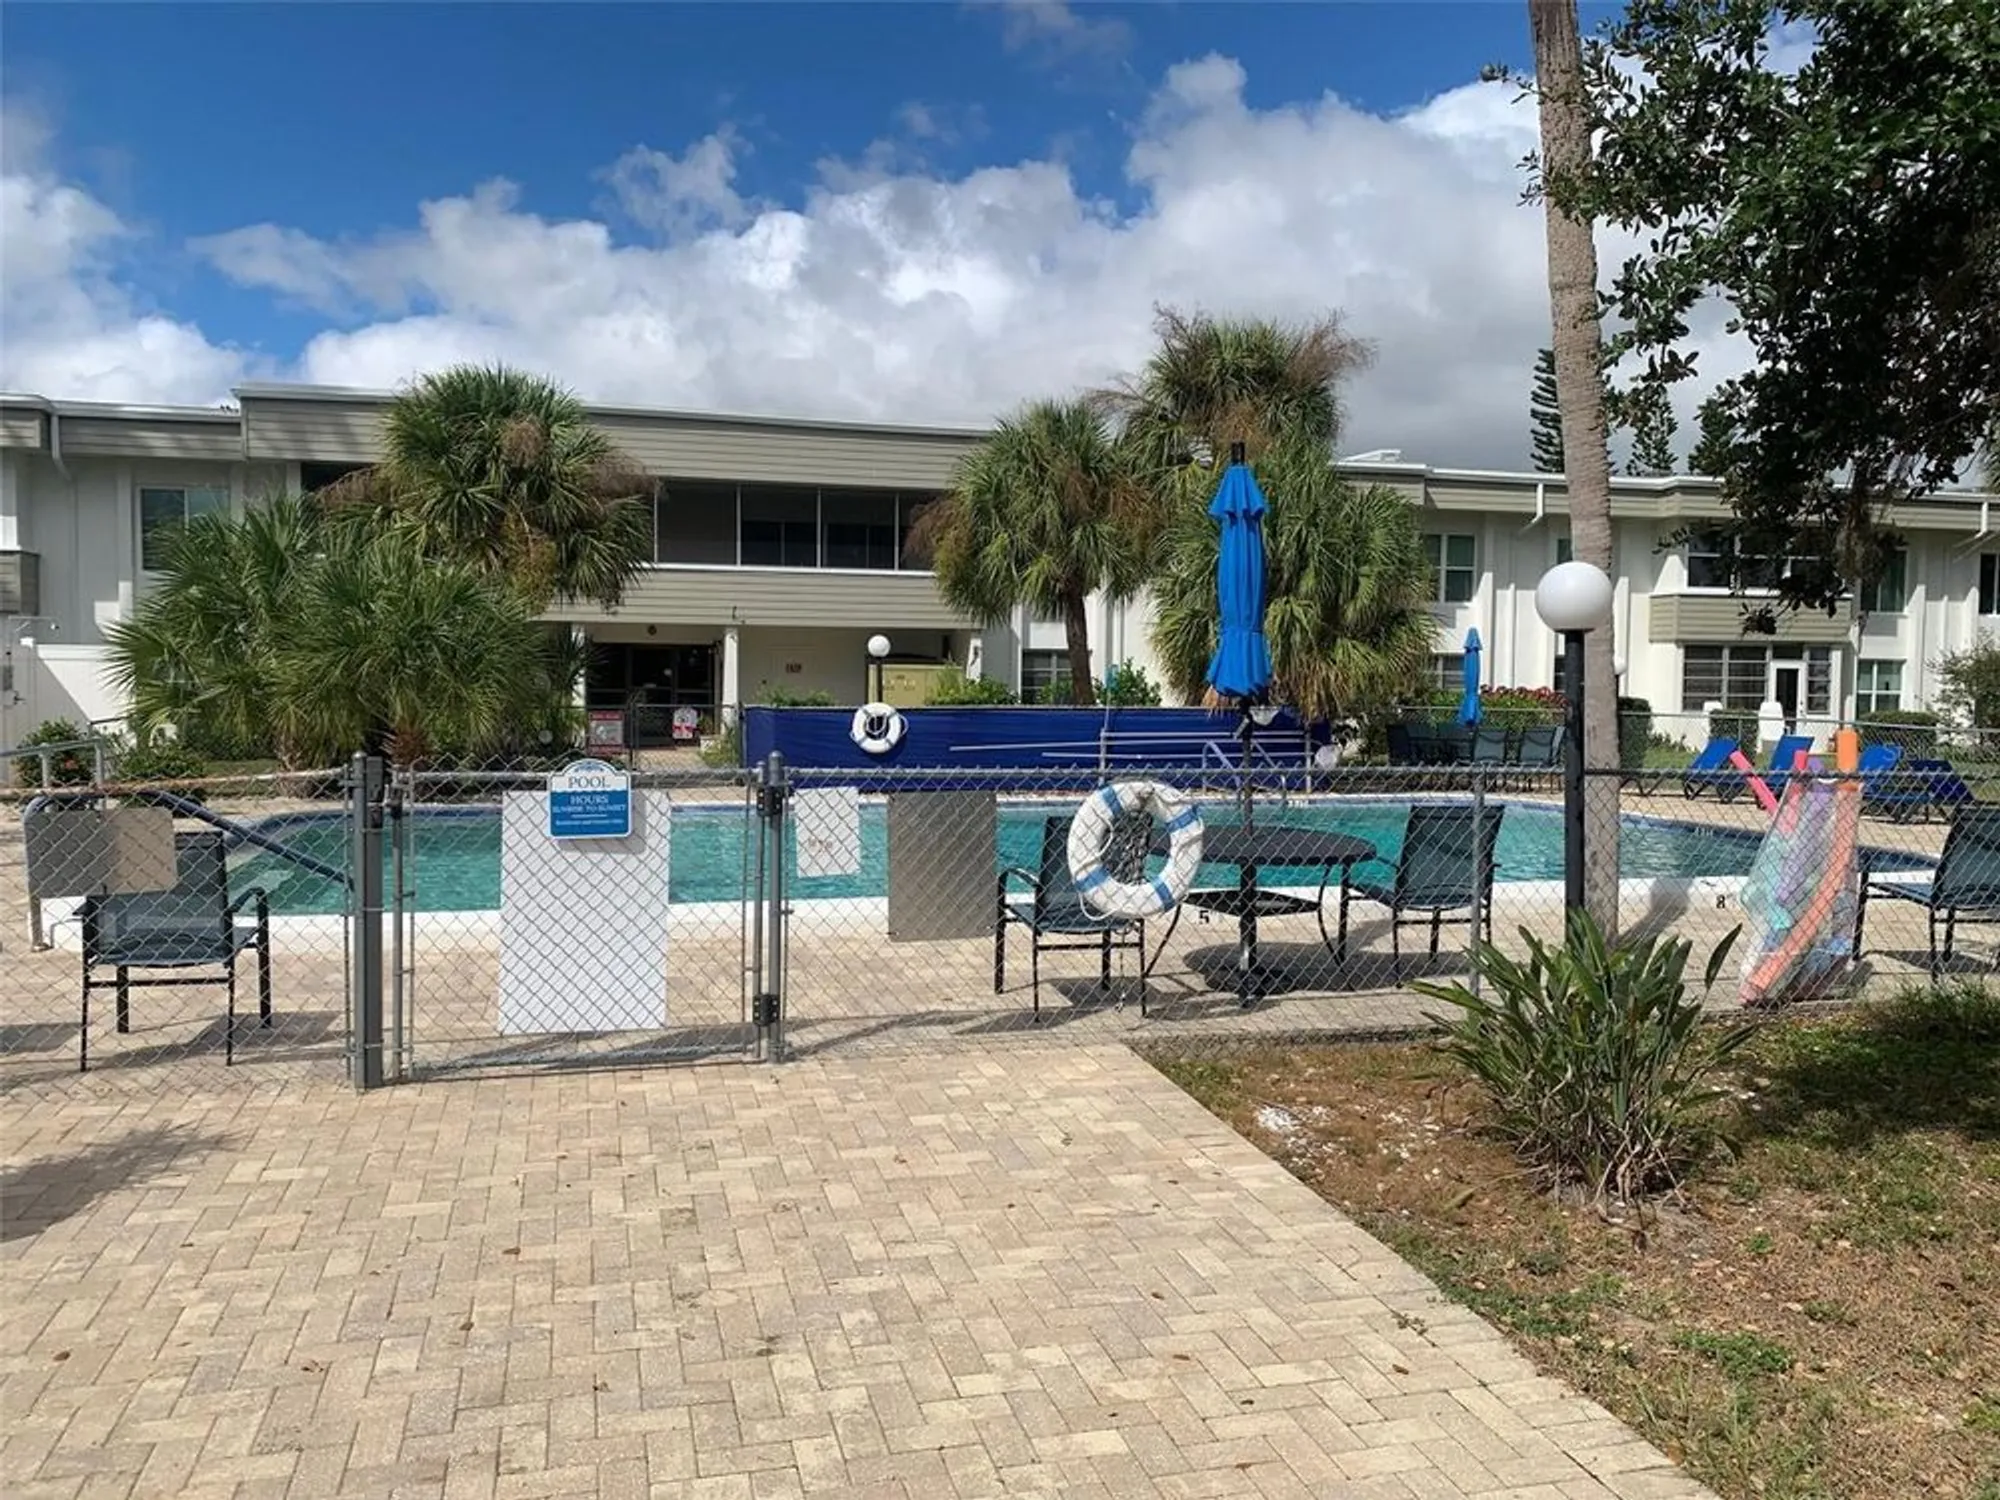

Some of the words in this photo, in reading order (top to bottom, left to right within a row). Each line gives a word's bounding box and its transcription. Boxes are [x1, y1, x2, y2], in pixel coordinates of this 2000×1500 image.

[568, 776, 610, 788] POOL
[570, 795, 609, 805] HOURS
[1200, 910, 1209, 924] 5
